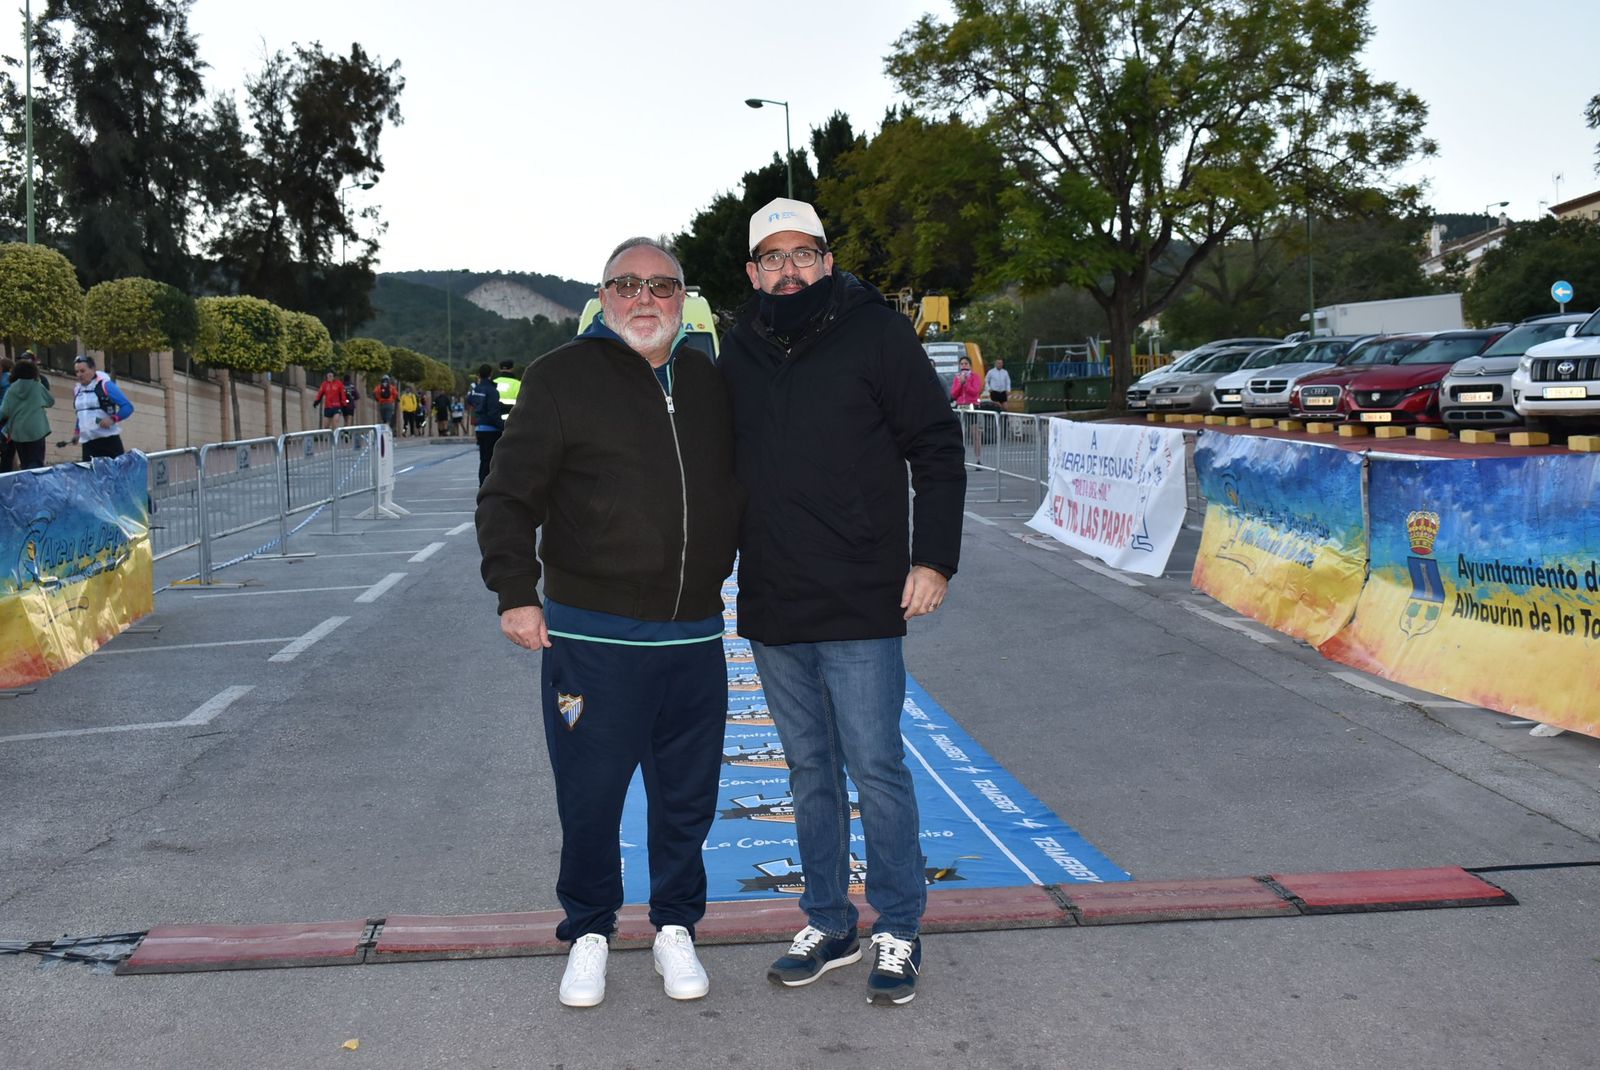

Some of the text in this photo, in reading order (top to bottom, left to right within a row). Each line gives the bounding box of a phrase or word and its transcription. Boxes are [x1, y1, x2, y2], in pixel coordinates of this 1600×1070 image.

[1091, 430, 1098, 450] A
[1086, 454, 1098, 475] DE
[1099, 455, 1134, 480] YEGUAS
[1053, 495, 1064, 528] EL
[1080, 503, 1100, 541] LAS
[1099, 508, 1133, 549] PAPAS
[1457, 552, 1600, 593] Ayuntamiento d
[1452, 592, 1523, 628] Alhaurín
[1529, 601, 1552, 632] de
[1555, 603, 1575, 636] la
[719, 778, 788, 787] Conquis
[702, 839, 731, 850] La
[737, 837, 798, 848] Conqu
